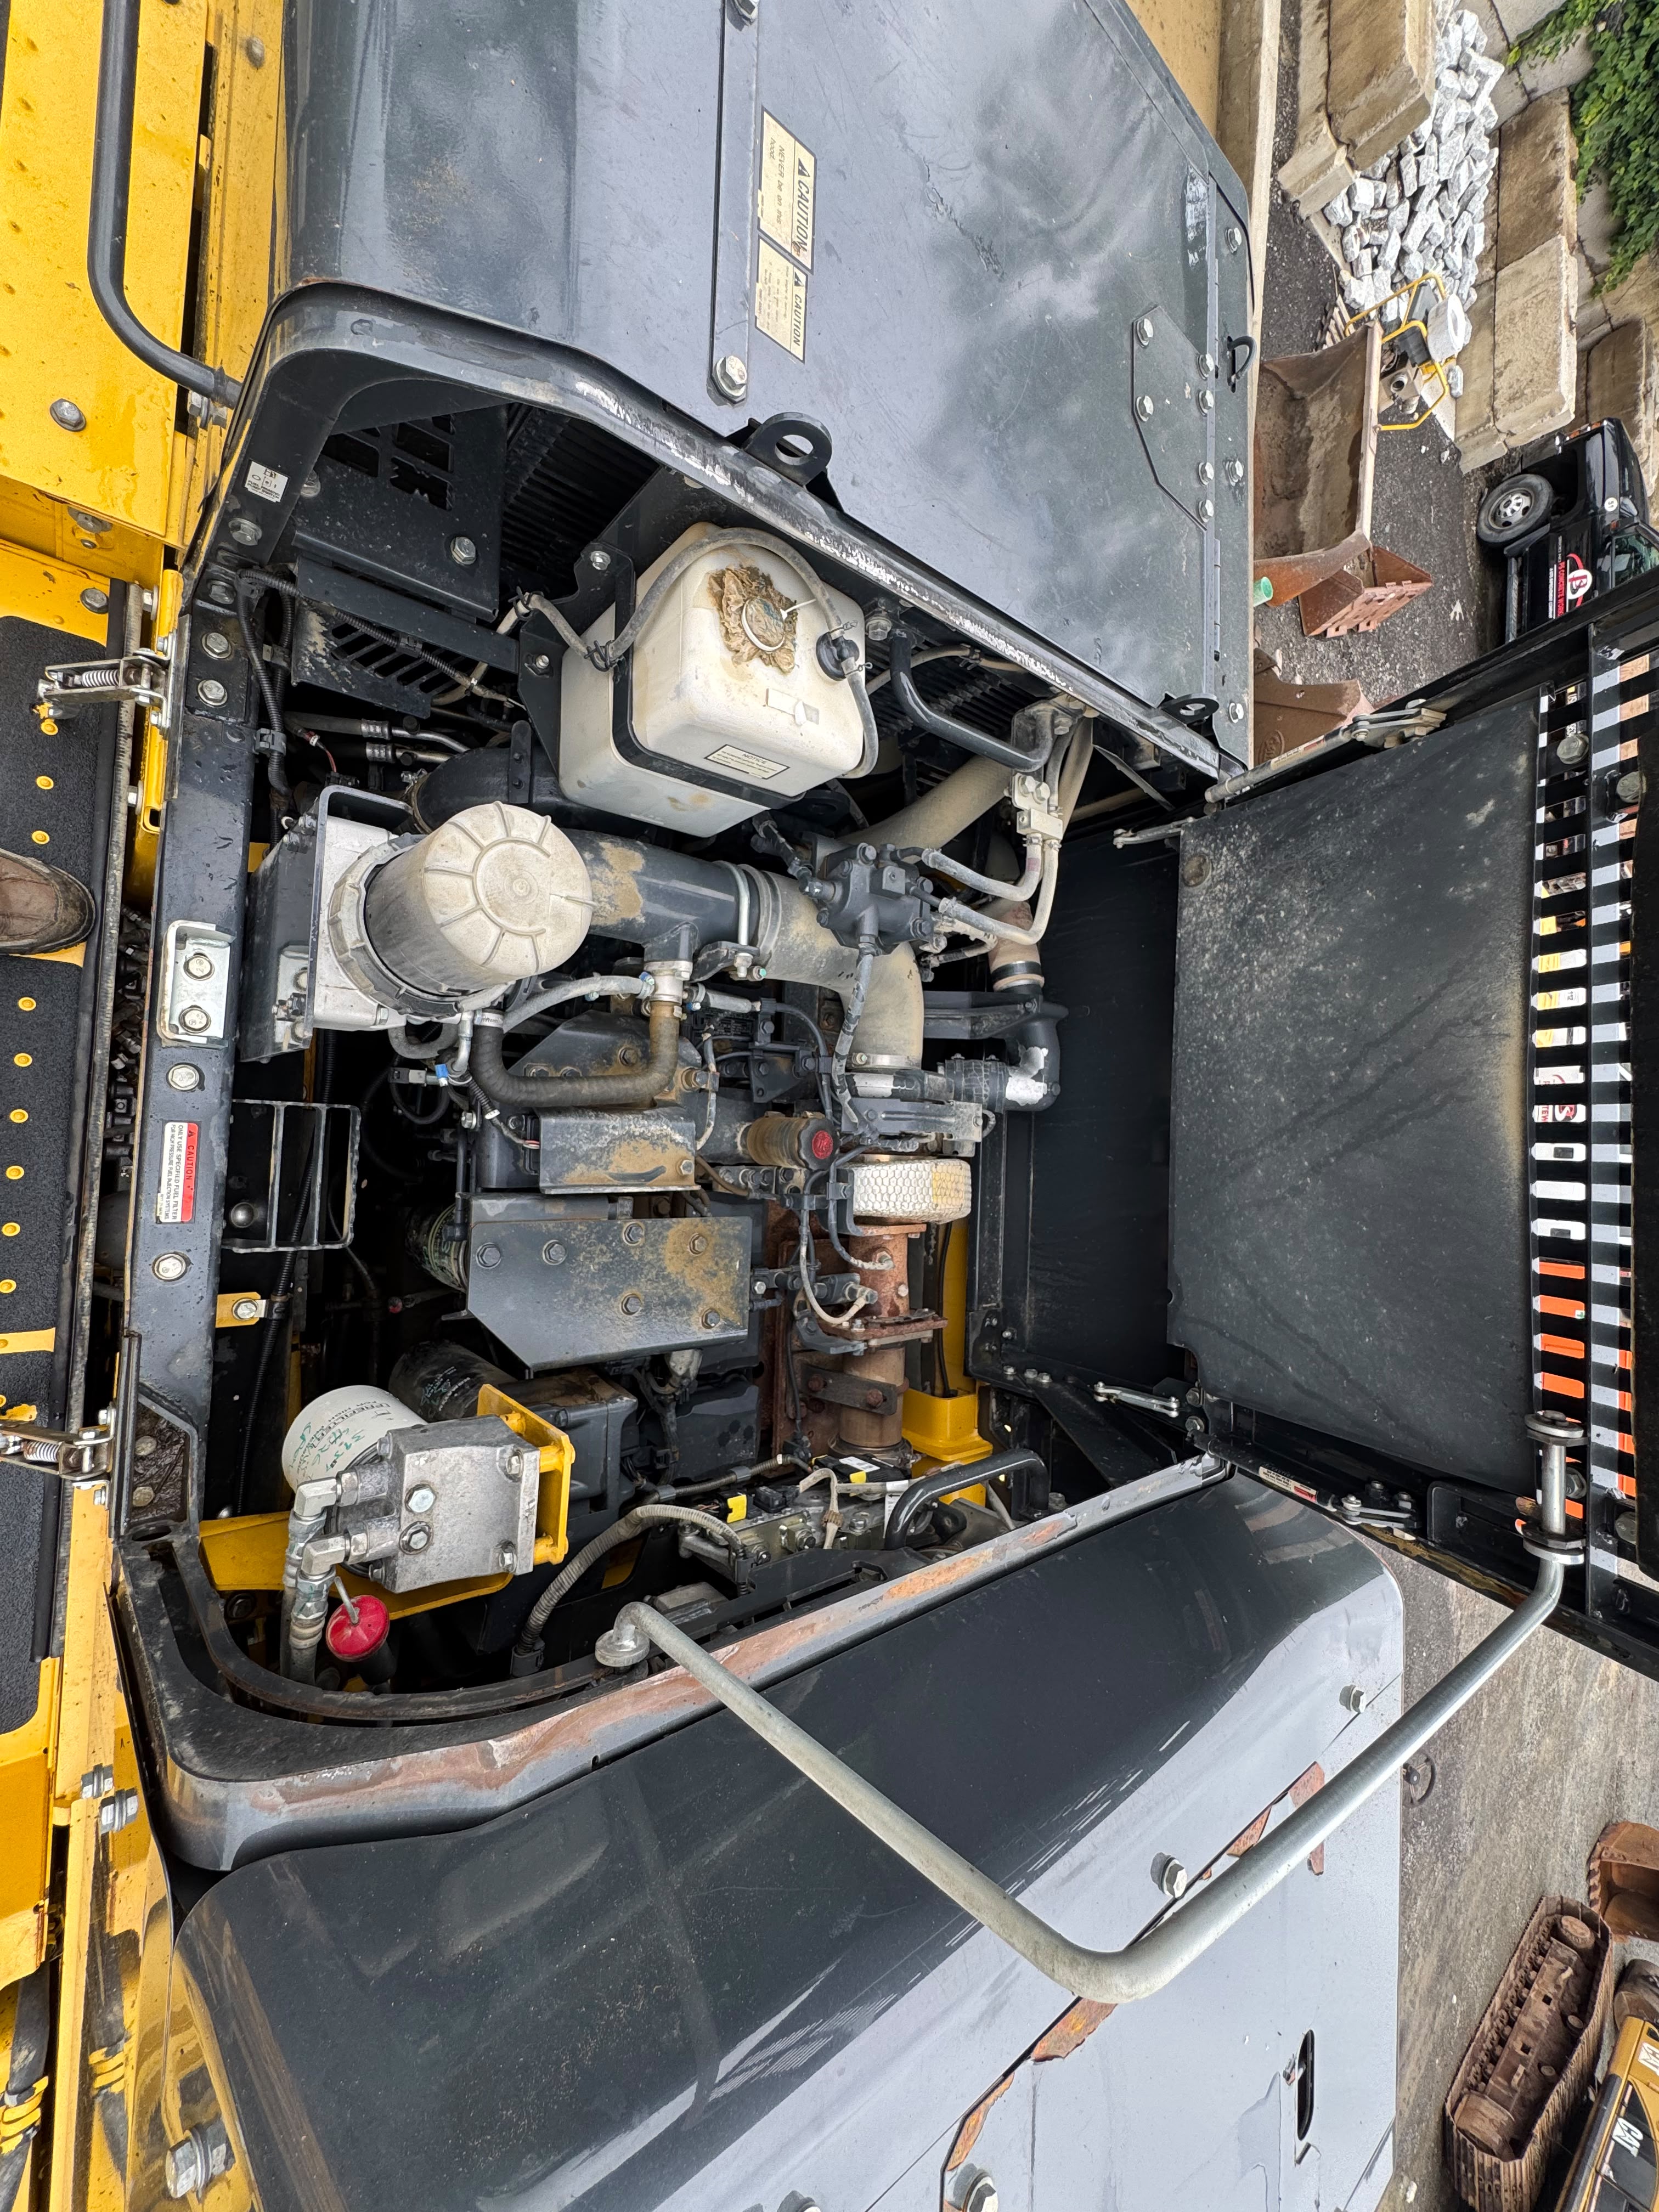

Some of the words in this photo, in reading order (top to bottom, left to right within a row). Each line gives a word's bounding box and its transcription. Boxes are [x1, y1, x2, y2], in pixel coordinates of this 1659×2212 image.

[777, 180, 784, 189] be
[777, 195, 782, 206] on
[795, 179, 810, 252] CAUTION
[793, 294, 802, 346] CAUTION
[742, 754, 768, 764] NOTICE
[185, 1145, 195, 1181] CAUTION
[311, 1403, 384, 1448] PREFILTER
[1637, 2042, 1659, 2076] CAT
[1611, 2117, 1644, 2158] CAT
